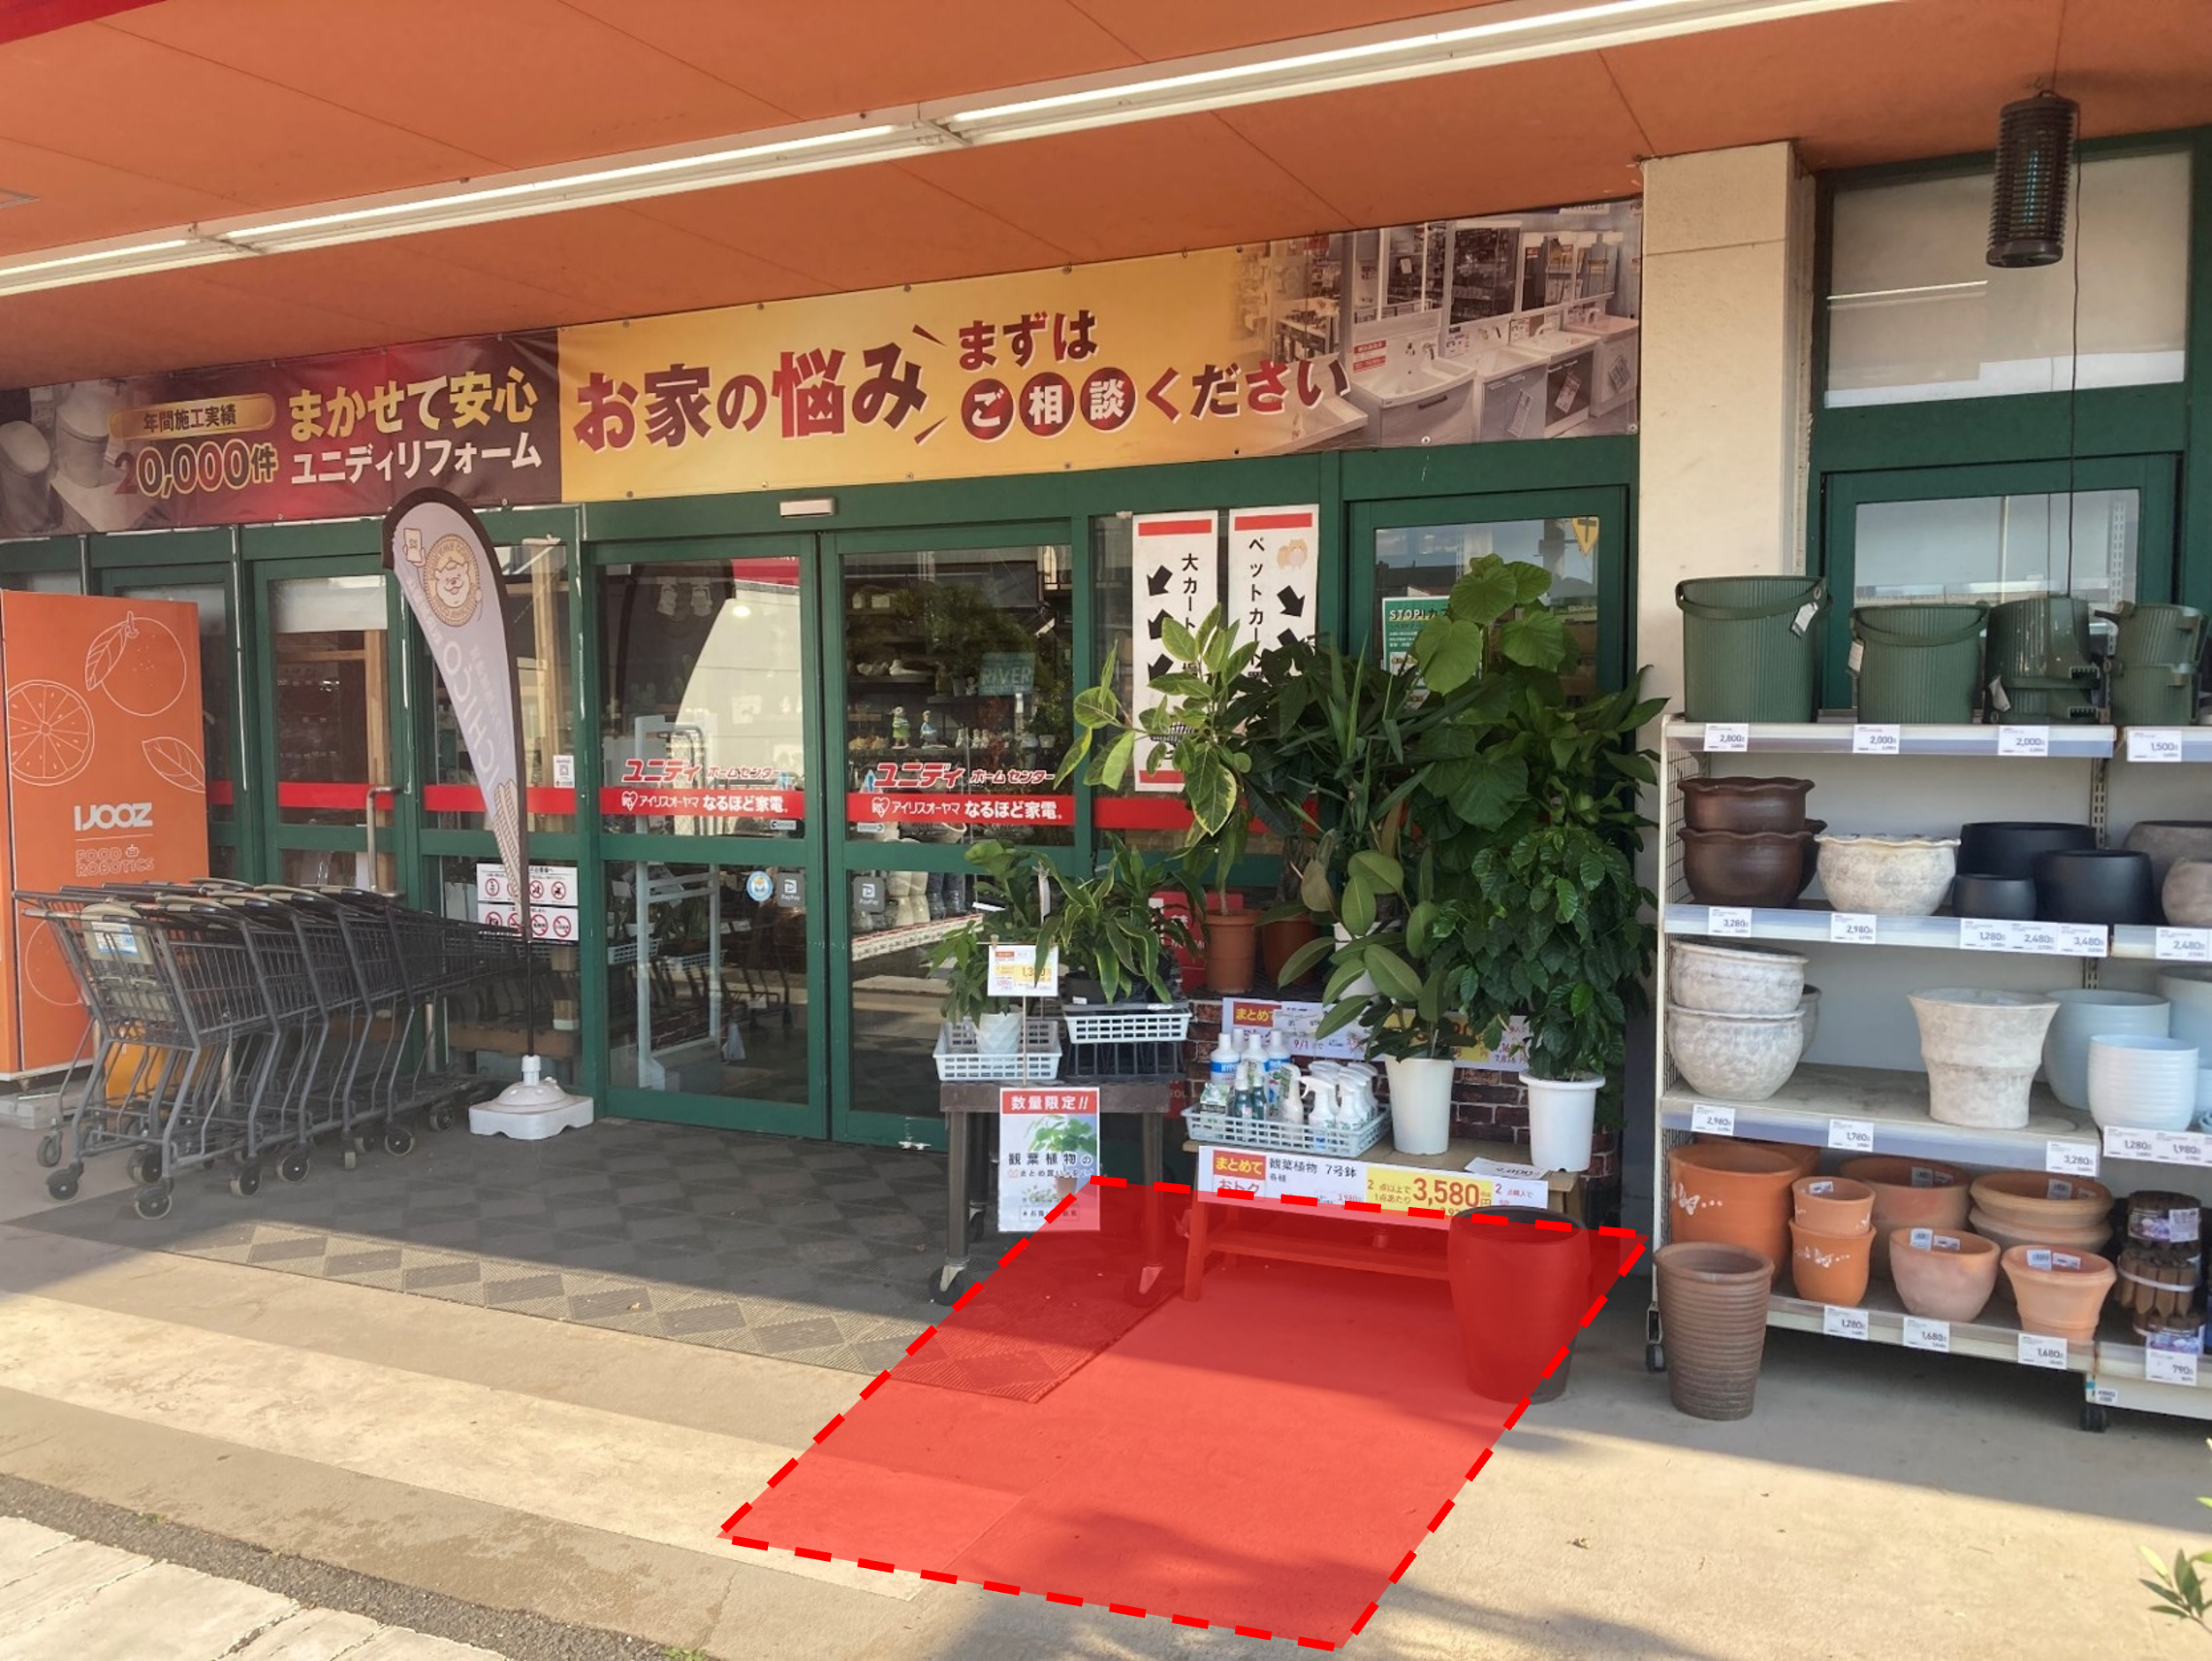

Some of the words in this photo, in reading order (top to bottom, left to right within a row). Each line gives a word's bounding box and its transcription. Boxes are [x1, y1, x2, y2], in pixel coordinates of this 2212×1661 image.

[958, 310, 1097, 371] まずは
[143, 404, 236, 434] 年間施工実績
[289, 365, 539, 442] まかせて安心
[572, 342, 929, 452] お家の悩み
[964, 358, 1352, 432] ご相談ください
[114, 438, 279, 500] 20,000件
[291, 432, 541, 485] ユニディリフォーム
[621, 758, 702, 783] ユニディ
[873, 763, 965, 788] ユニディ
[1009, 1152, 1092, 1166] 観葉植物の
[1215, 1157, 1263, 1175] まとめて
